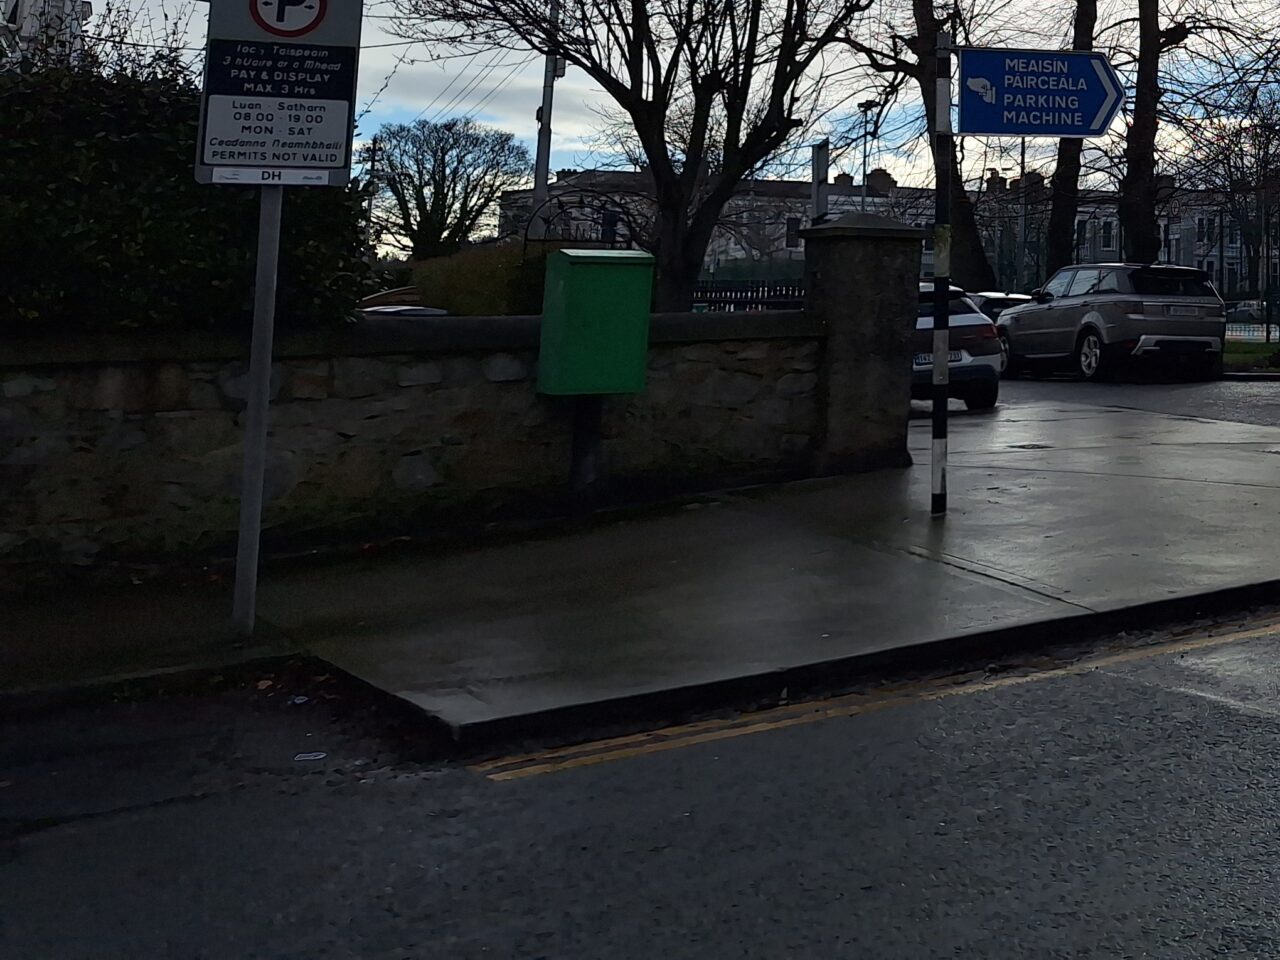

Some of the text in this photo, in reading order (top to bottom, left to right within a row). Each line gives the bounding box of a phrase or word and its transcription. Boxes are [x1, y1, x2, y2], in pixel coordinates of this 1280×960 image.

[222, 55, 232, 65] 3
[1005, 58, 1068, 74] MEAISÍN
[230, 69, 331, 83] PAY & DISPLAY
[1004, 73, 1088, 91] PÁIRCEÁLA
[243, 83, 316, 95] MAX 3 Hrs
[232, 100, 262, 110] Luan
[277, 101, 326, 113] Satharn
[1003, 94, 1079, 109] PARKING
[1003, 111, 1083, 126] MACHINE
[241, 125, 274, 135] MON
[287, 126, 313, 136] SAT
[209, 137, 267, 148] Ceadanna
[211, 150, 338, 163] PERMITS NOT VALID
[261, 171, 282, 181] DH
